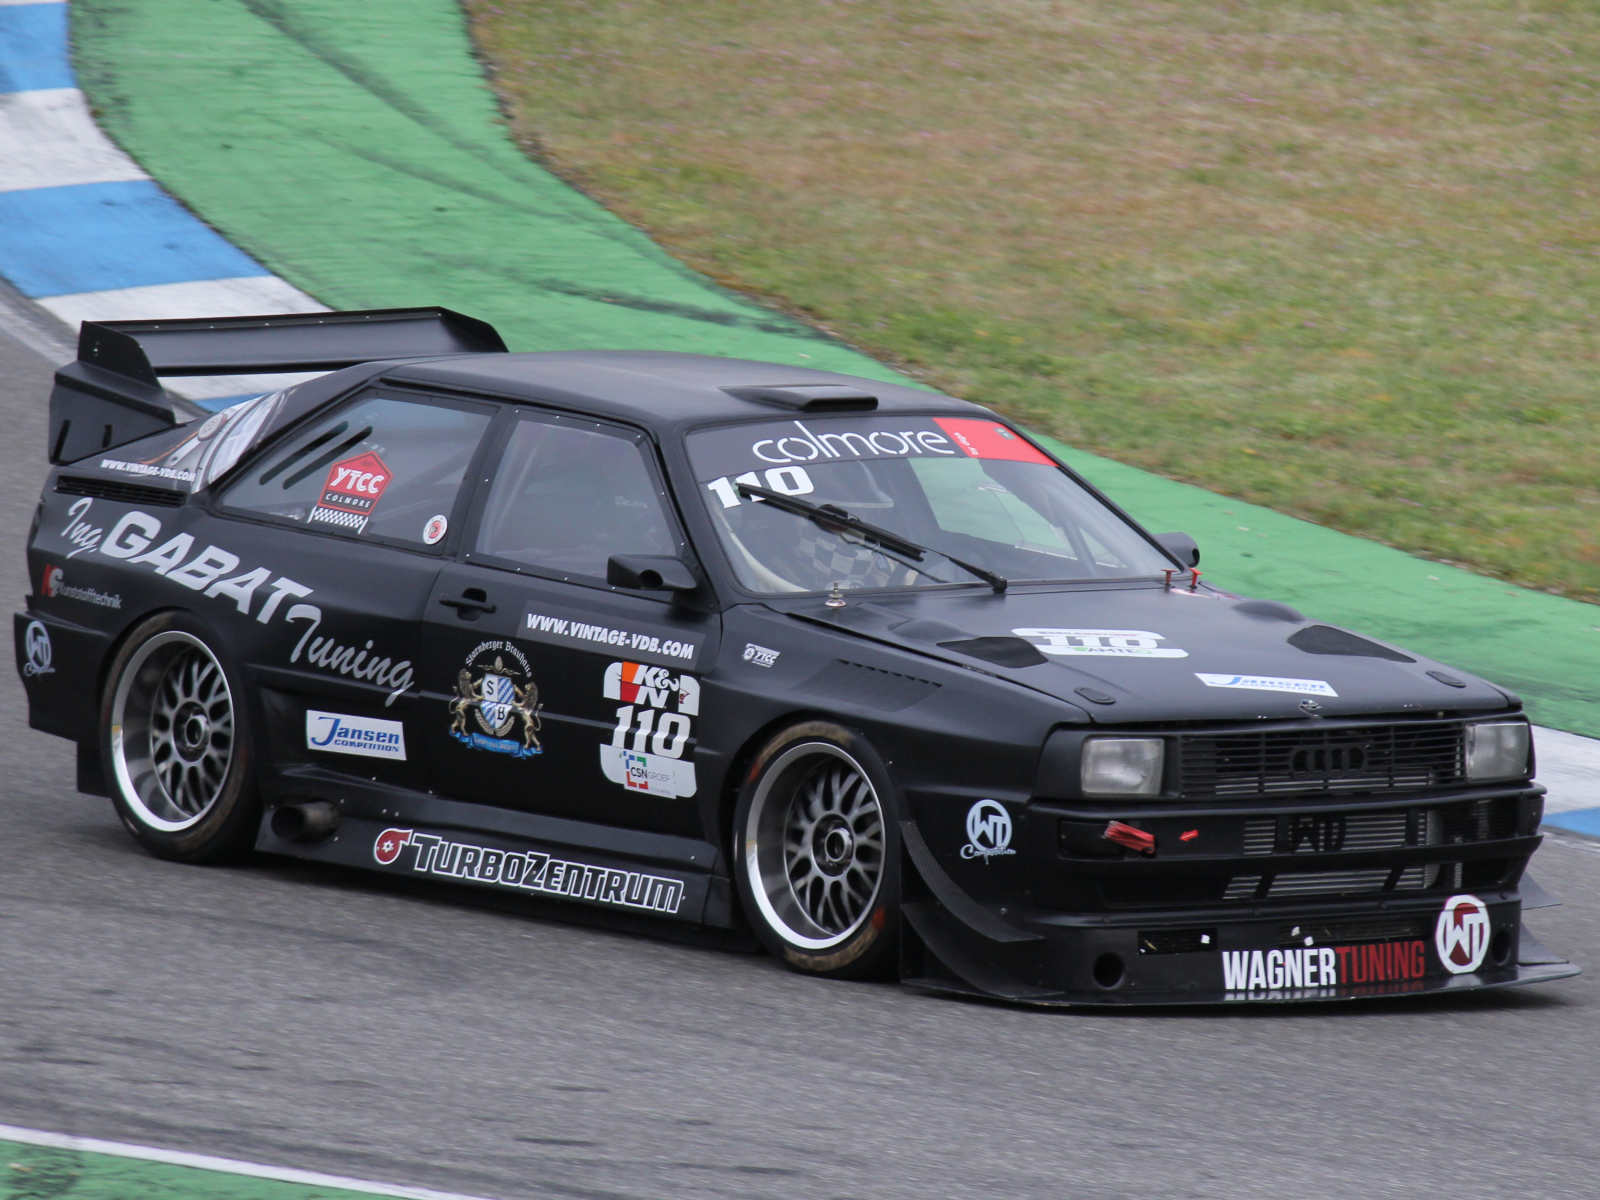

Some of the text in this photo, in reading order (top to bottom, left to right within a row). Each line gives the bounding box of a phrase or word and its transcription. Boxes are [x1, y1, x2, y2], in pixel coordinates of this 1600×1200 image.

[752, 420, 956, 463] colmore
[100, 459, 196, 483] WWW.VINTAGE-VDB.COM
[329, 467, 385, 494] YTCC
[325, 493, 371, 508] COLMORE
[99, 510, 313, 625] GABAT
[285, 603, 415, 707] Tuning
[526, 613, 695, 660] WWW.VINTAGE-VDB.COM
[505, 641, 532, 678] Brauhaus
[310, 716, 400, 746] Jansen
[334, 738, 399, 752] COMPETITION
[611, 705, 691, 759] 110
[630, 766, 648, 779] CSN
